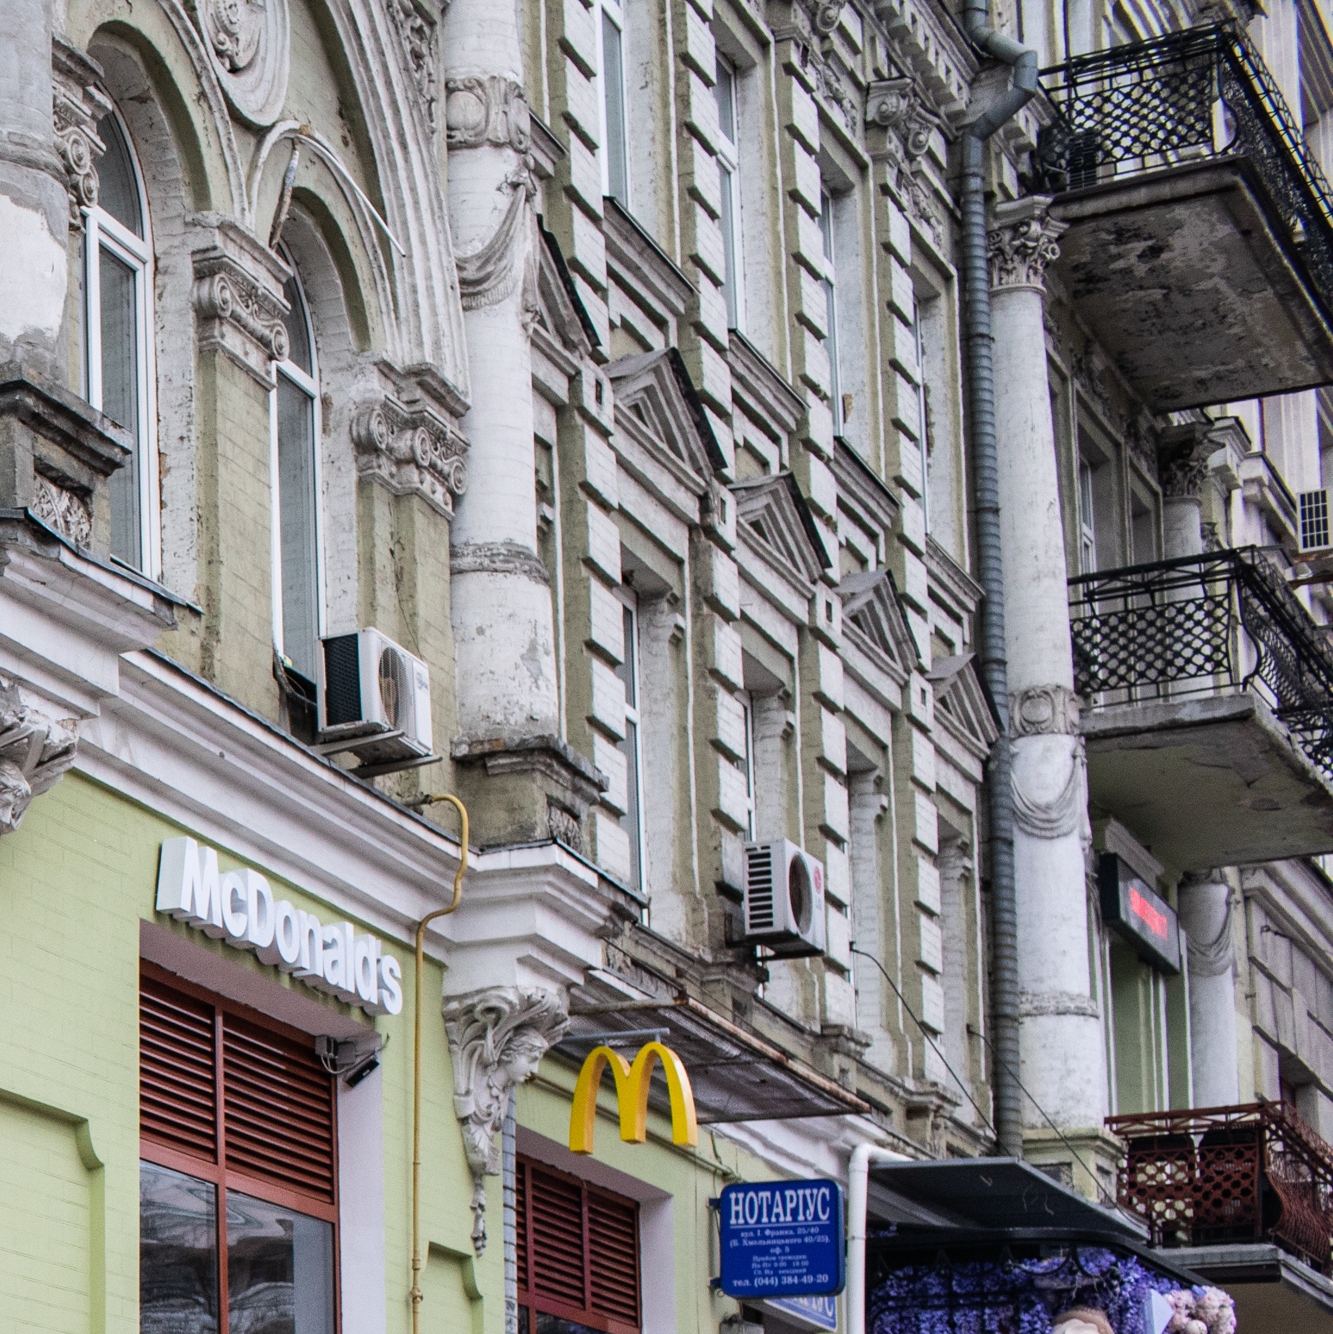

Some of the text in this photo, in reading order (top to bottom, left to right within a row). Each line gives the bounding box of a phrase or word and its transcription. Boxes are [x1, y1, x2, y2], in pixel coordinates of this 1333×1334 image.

[155, 836, 403, 1016] McDonald's
[730, 1187, 829, 1224] НОТАРІУС
[754, 1277, 778, 1288] (044)
[781, 1275, 828, 1284] 384-49-20
